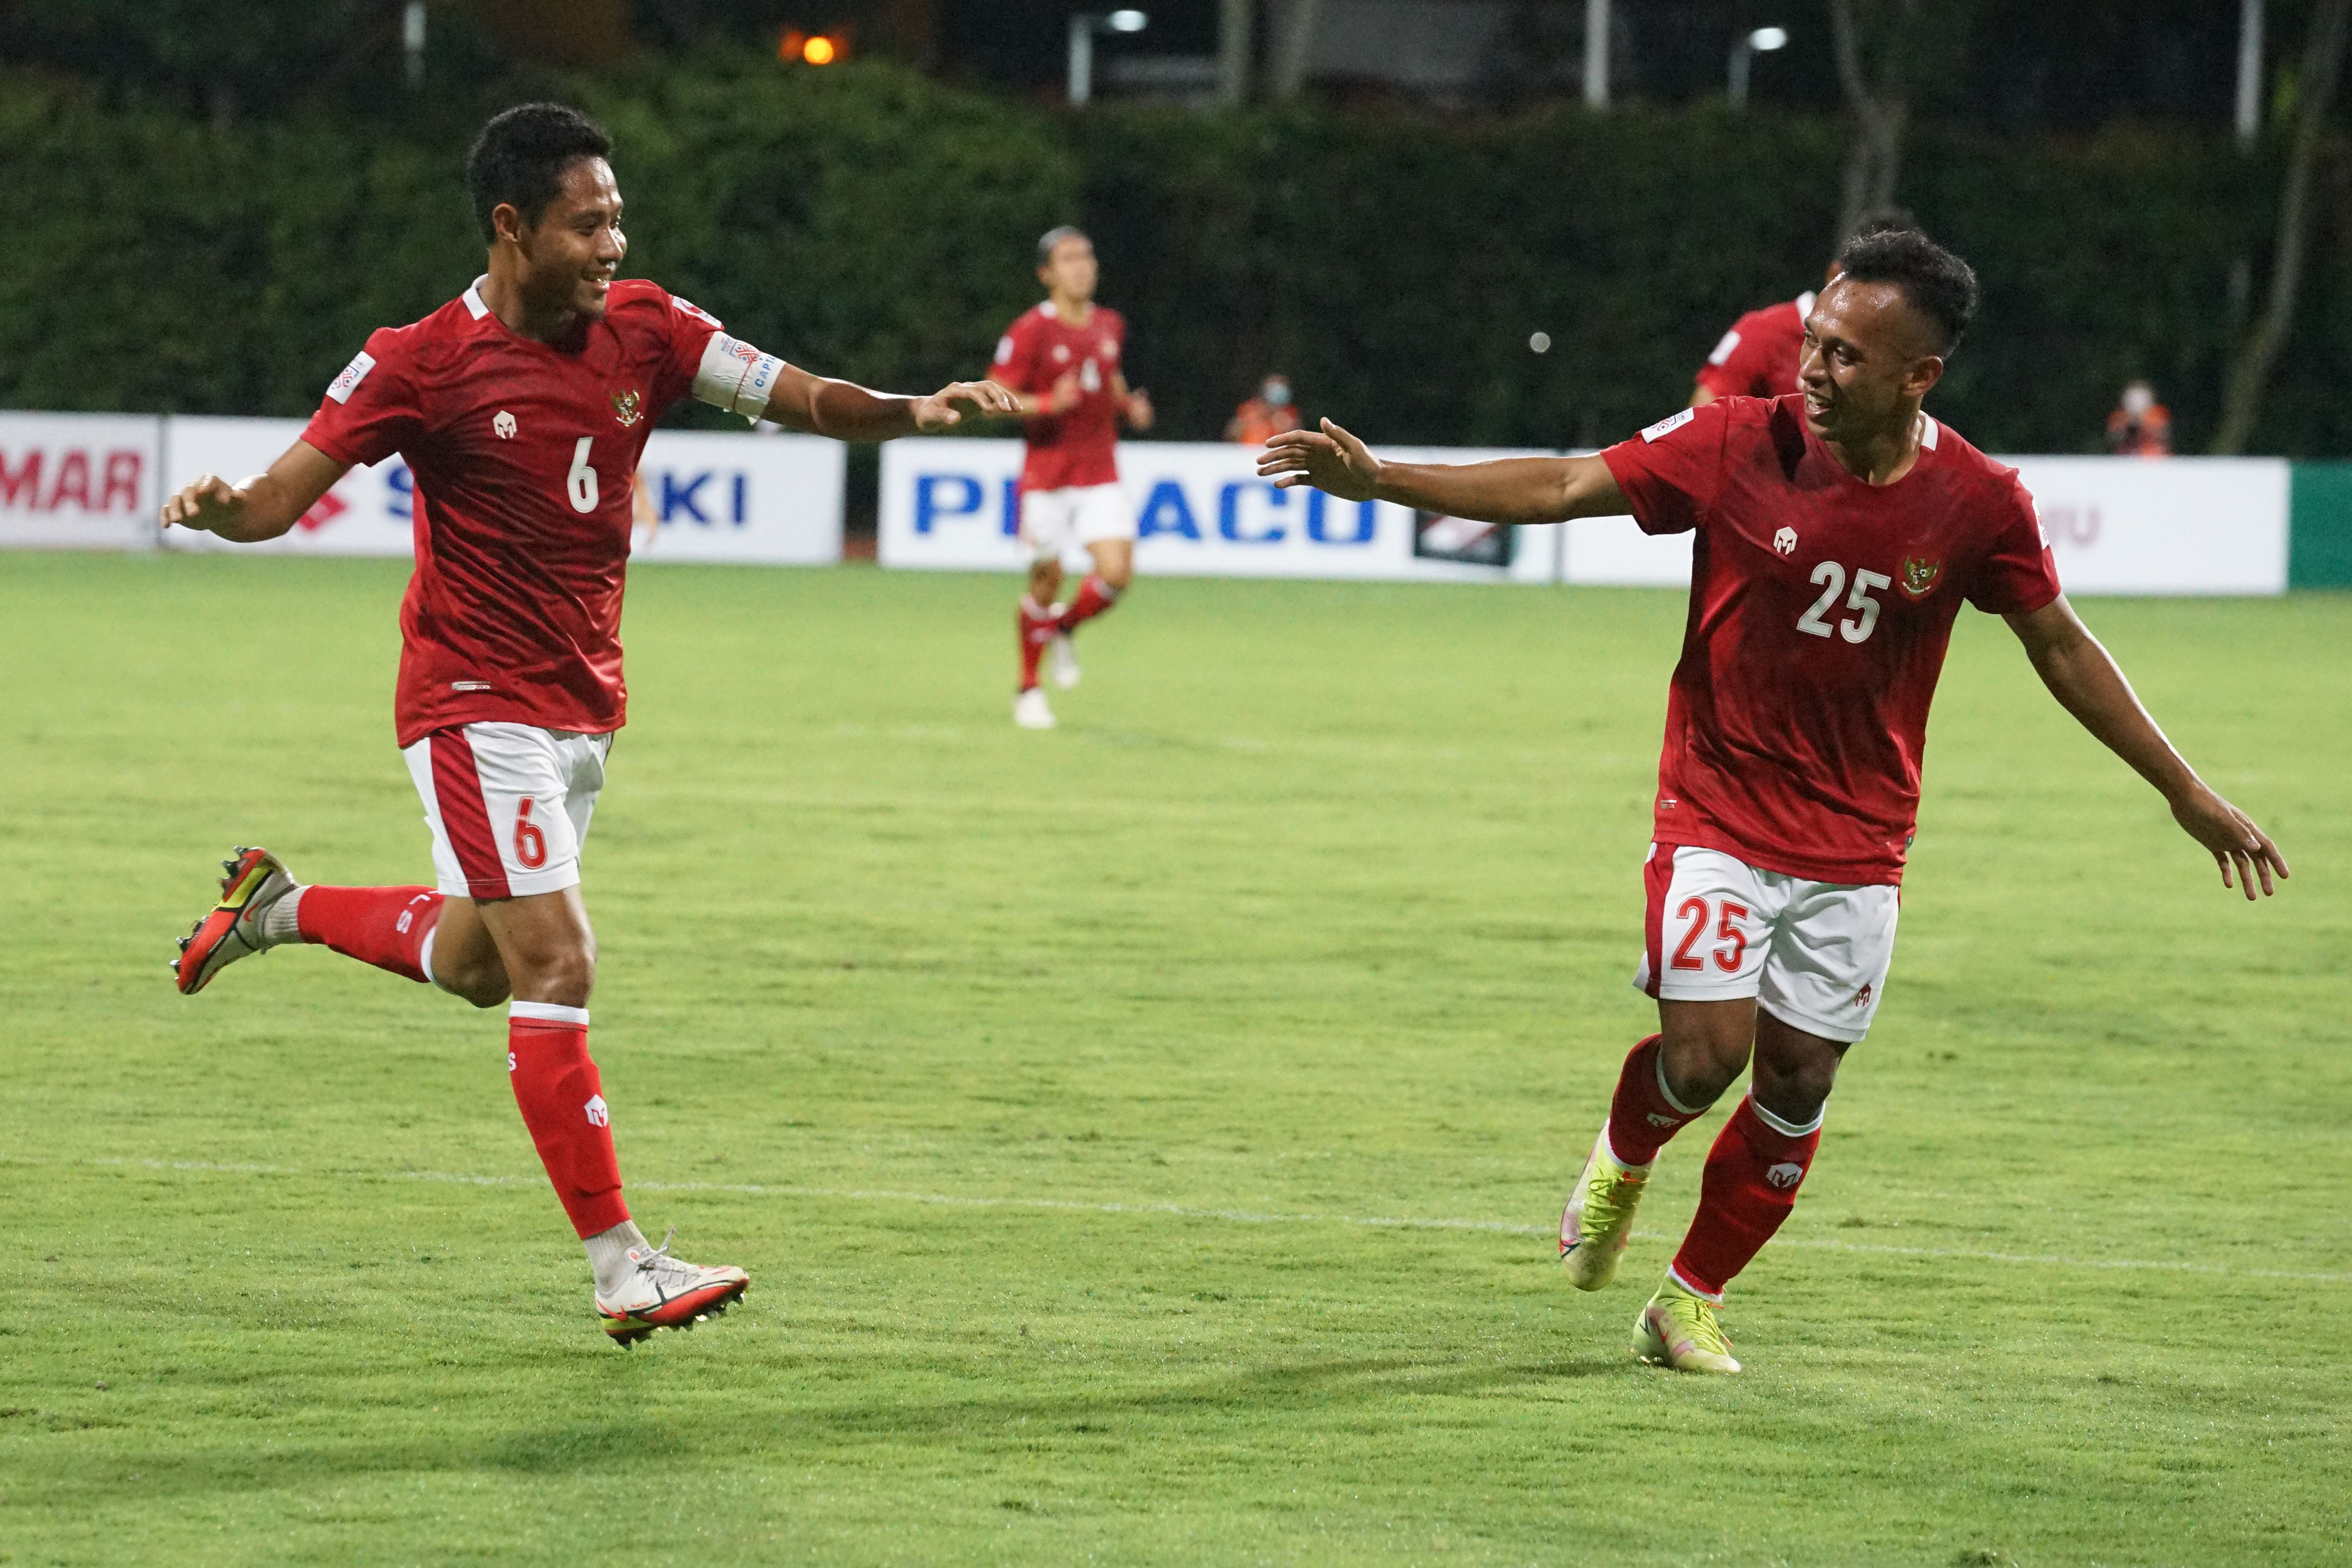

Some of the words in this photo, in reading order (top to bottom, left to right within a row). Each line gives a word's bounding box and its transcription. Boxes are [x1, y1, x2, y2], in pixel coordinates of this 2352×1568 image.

[567, 436, 599, 513] 6
[1796, 561, 1891, 643] 25
[513, 796, 548, 870] 6
[1671, 895, 1749, 973] 25
